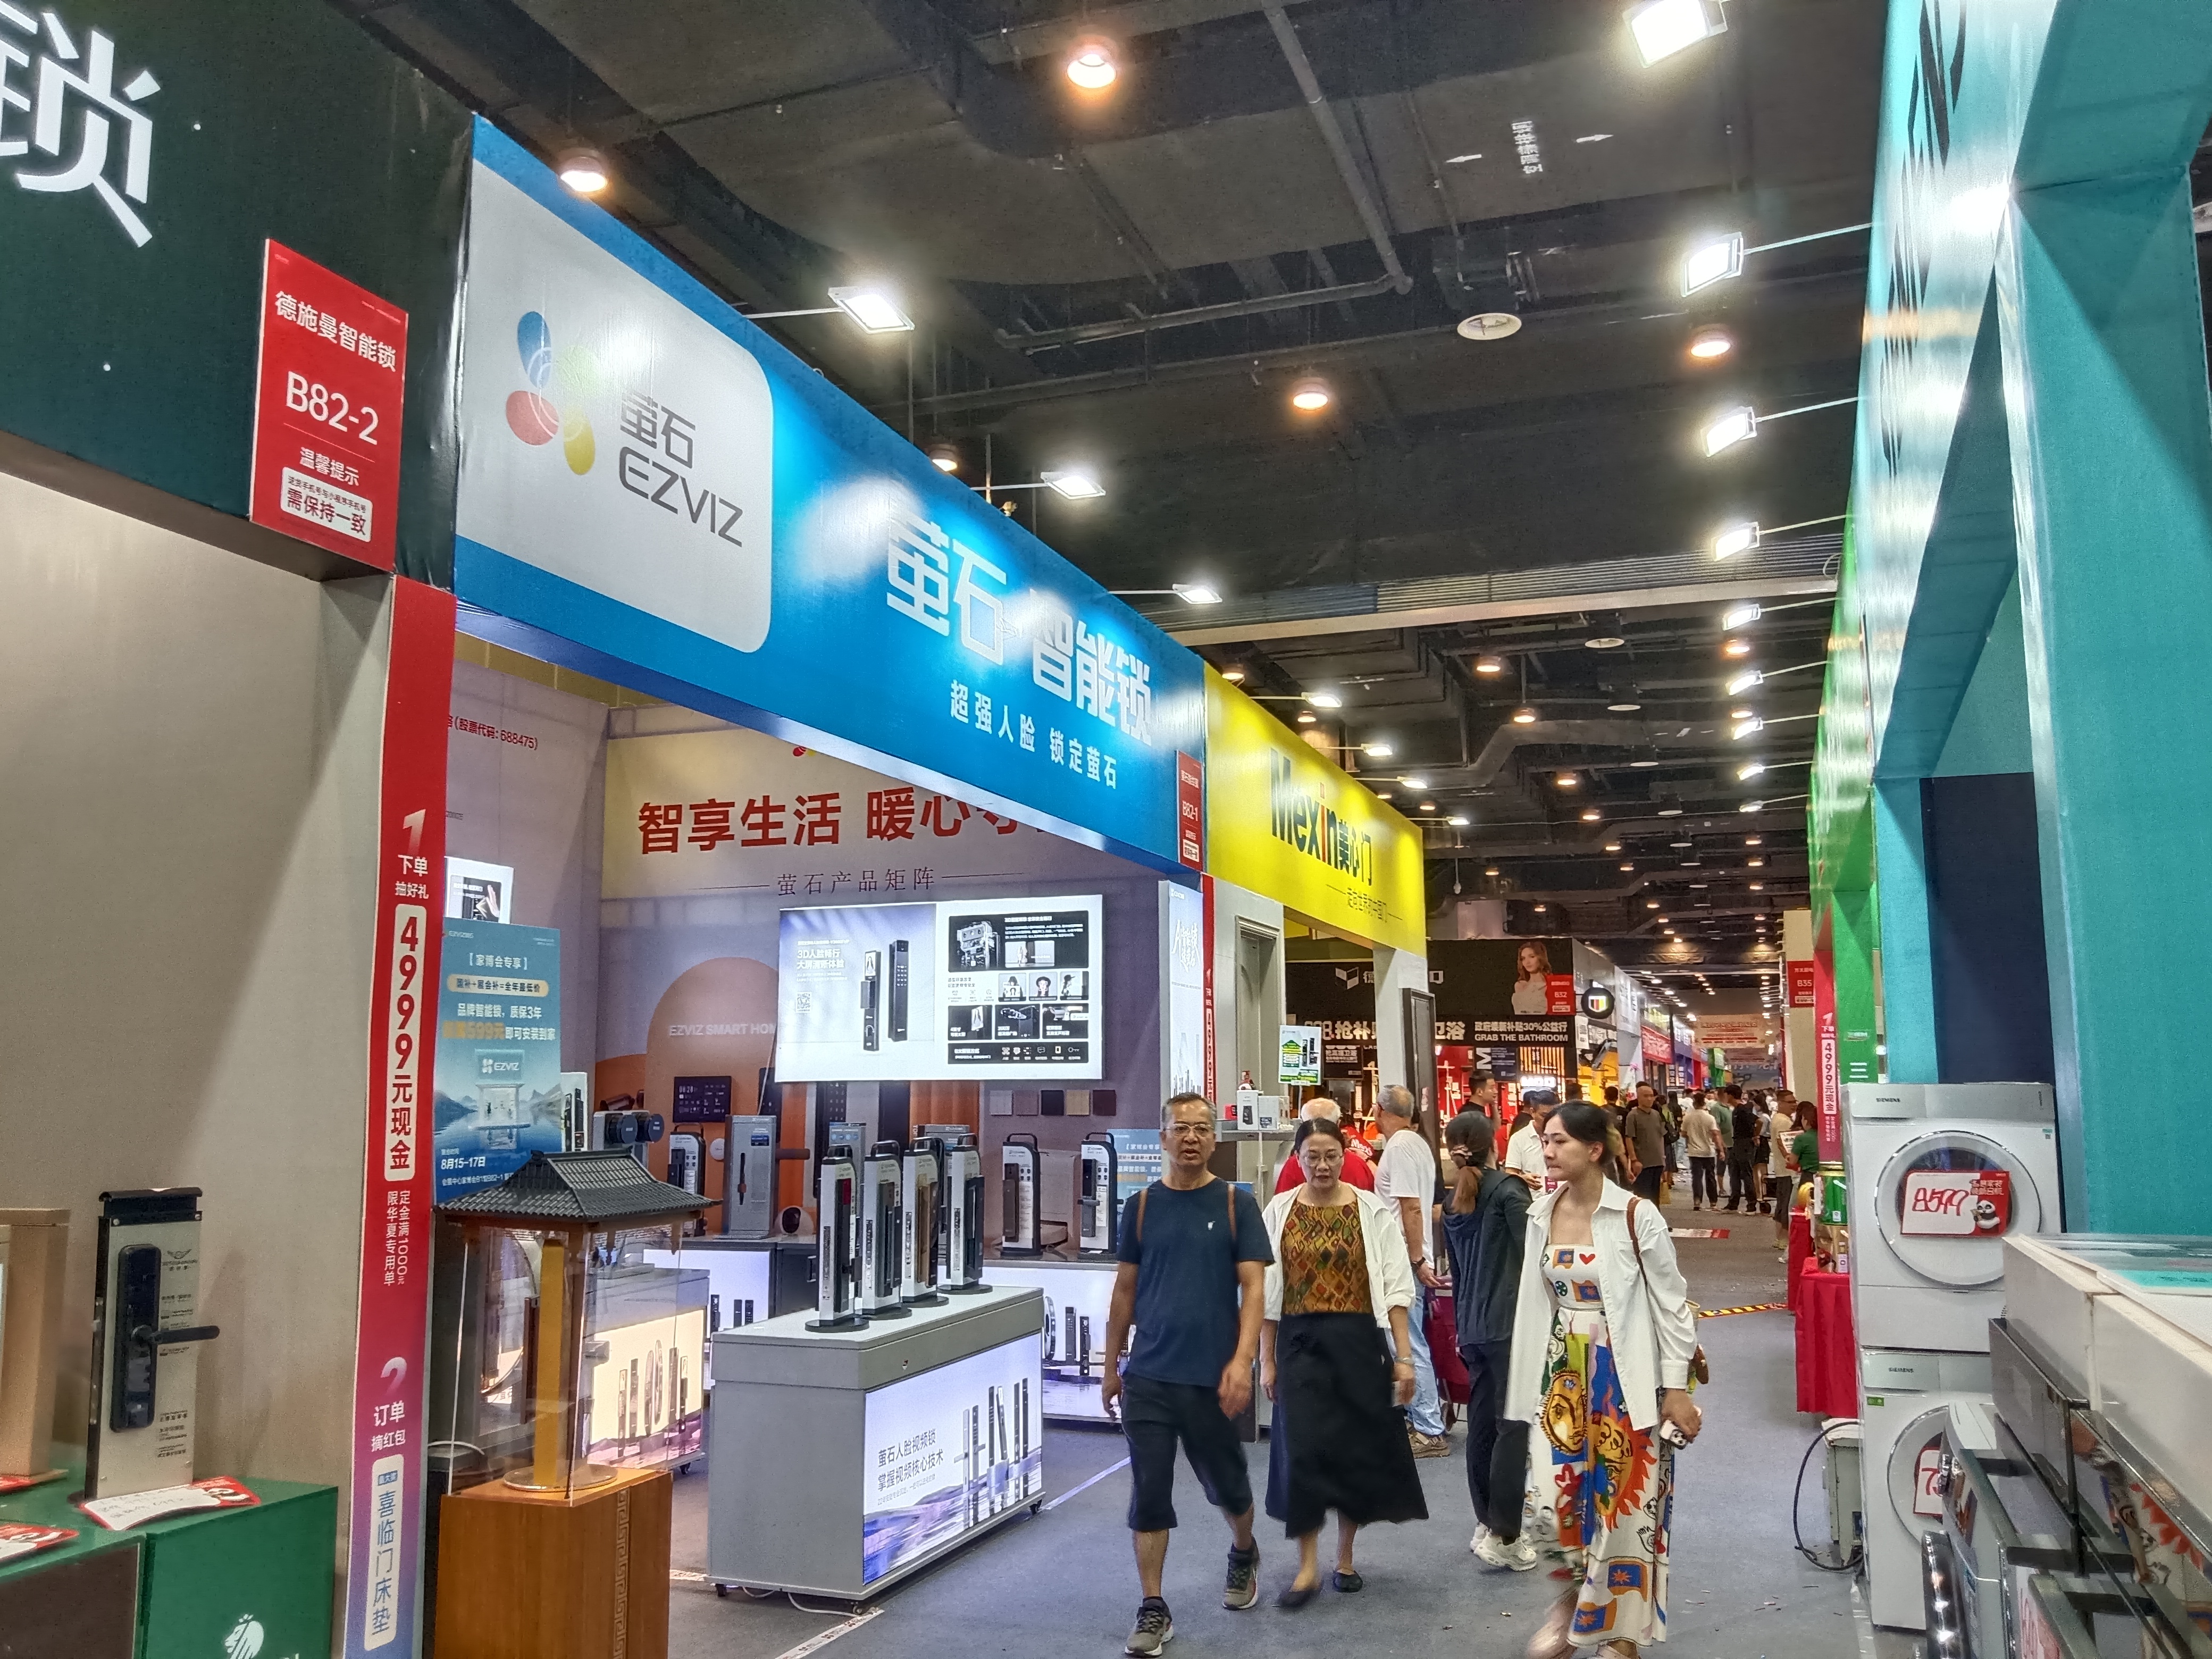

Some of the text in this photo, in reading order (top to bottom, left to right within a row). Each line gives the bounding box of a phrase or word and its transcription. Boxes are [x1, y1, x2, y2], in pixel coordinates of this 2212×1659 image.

[275, 291, 396, 372] 德施曼智能锁
[286, 371, 378, 445] B82-2
[620, 390, 696, 469] 萤石
[299, 447, 359, 486] 温馨提示
[288, 487, 366, 535] 需保持一致
[619, 446, 743, 548] EZVIZ
[887, 509, 1152, 746] 萤石 智能锁
[950, 679, 1117, 790] 超强人脸 锁定萤石
[403, 809, 426, 854] 1
[639, 787, 1045, 854] 智享生活 暖心
[398, 854, 428, 877] 下单
[777, 867, 935, 896] 萤石产品矩阵
[395, 881, 429, 899] 抽好礼
[390, 916, 419, 1170] 4999元现金
[669, 1025, 704, 1036] EZVIZ
[705, 1024, 748, 1035] SMART
[494, 1062, 520, 1071] EZVIZ
[1824, 1043, 1834, 1111] 4999元现金
[441, 1156, 486, 1170] 8月15-17日
[383, 1191, 398, 1286] 限华夏专用单
[381, 1356, 407, 1394] 2
[374, 1400, 405, 1428] 订单
[371, 1428, 406, 1452] 摘红包
[878, 1428, 936, 1468] 萤石人脸视频锁
[878, 1448, 943, 1492] 掌握视频核心技术
[371, 1490, 396, 1636] 喜临门床垫
